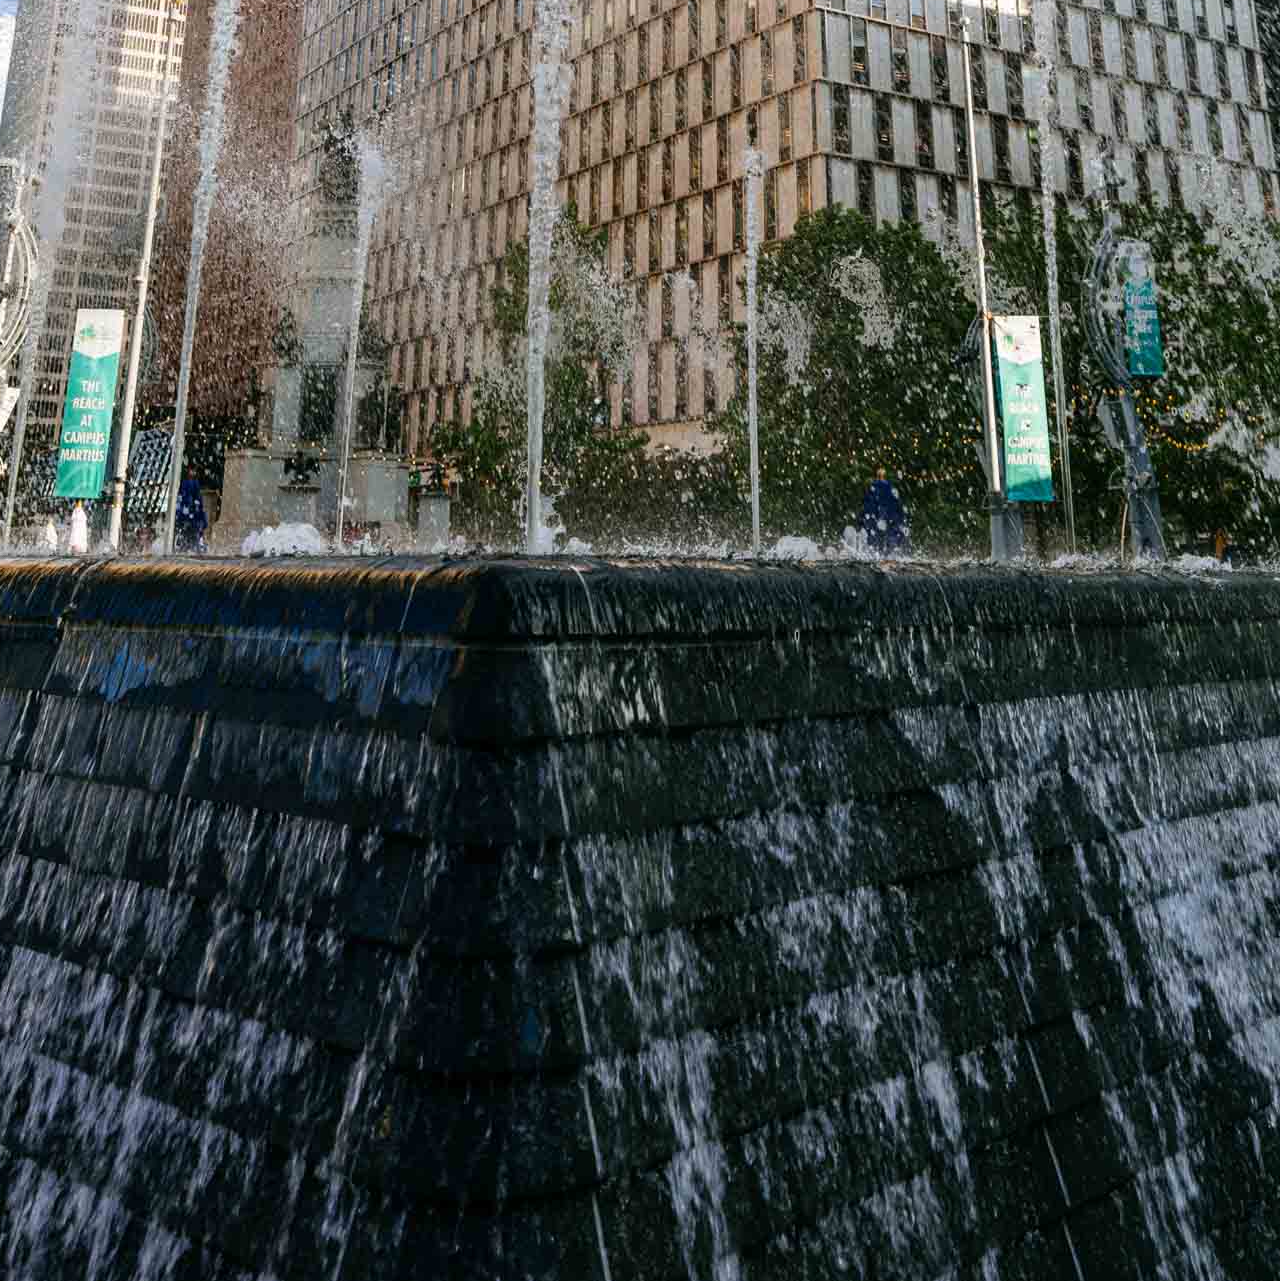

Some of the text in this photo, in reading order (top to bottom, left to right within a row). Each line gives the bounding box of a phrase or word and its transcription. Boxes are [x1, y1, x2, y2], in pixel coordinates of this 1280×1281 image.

[72, 396, 105, 409] BEACH
[80, 414, 94, 427] AT
[63, 431, 105, 444] CAMPUS
[60, 449, 105, 462] MARTIUS
